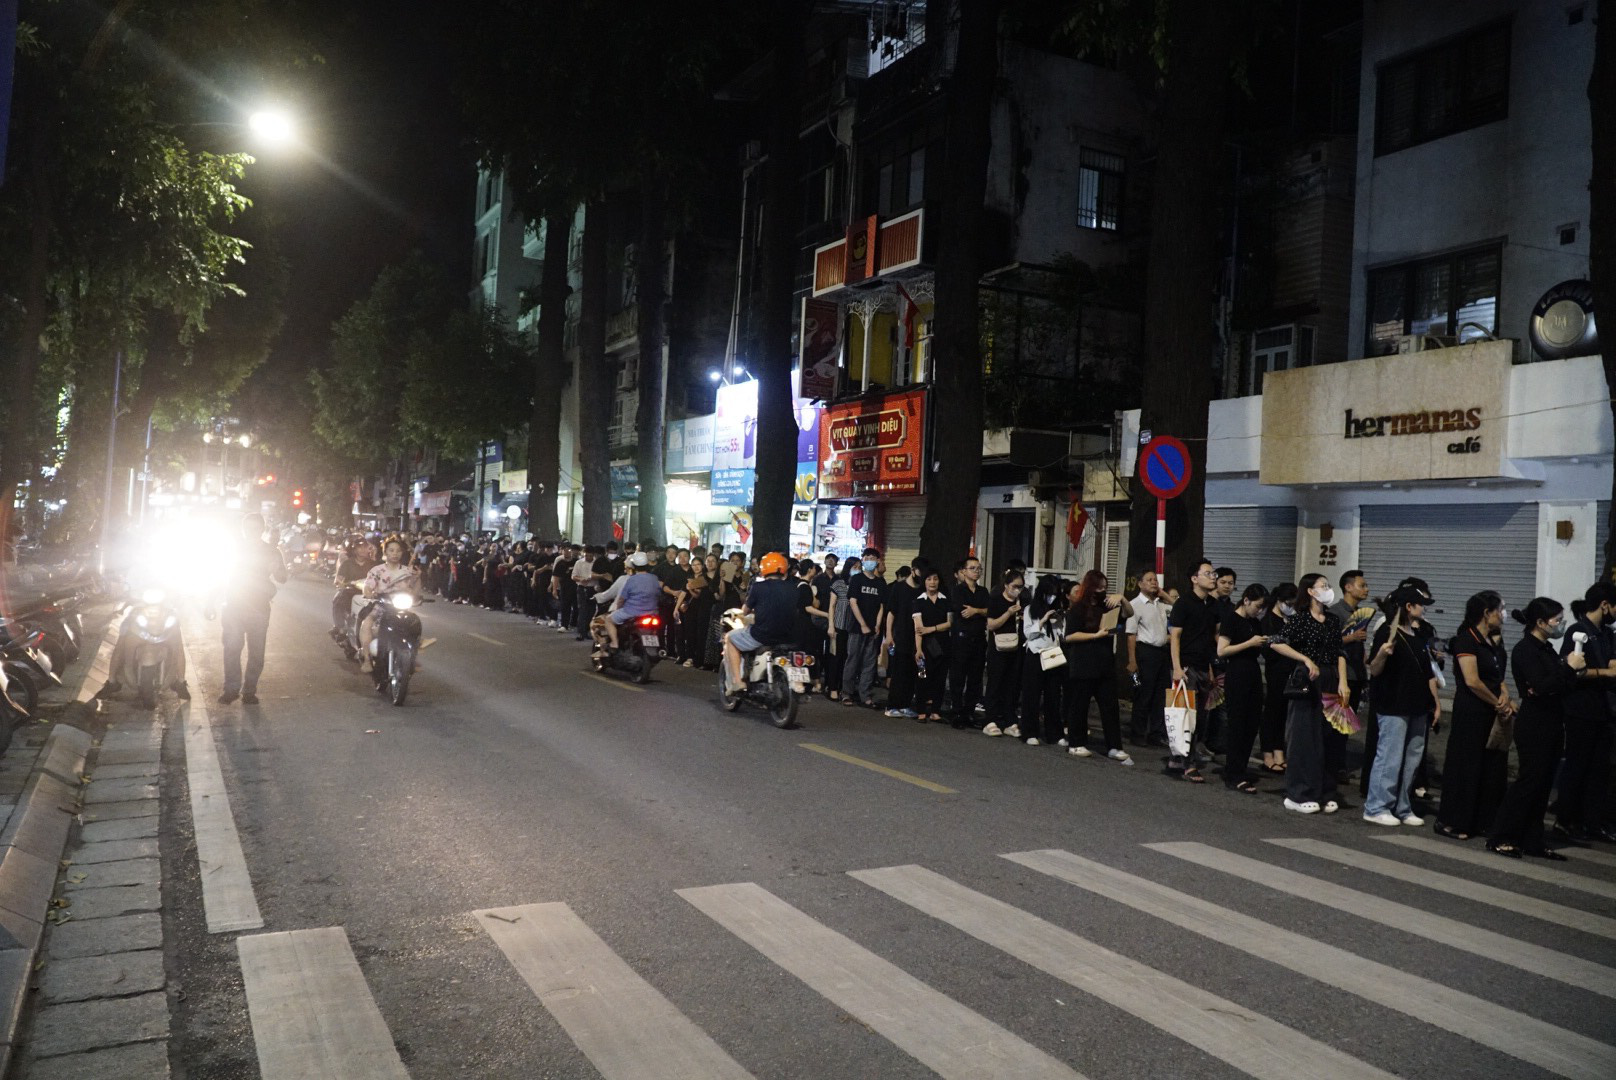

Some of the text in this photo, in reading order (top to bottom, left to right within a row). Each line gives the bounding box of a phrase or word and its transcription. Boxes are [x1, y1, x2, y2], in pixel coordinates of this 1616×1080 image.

[832, 428, 842, 442] VỊT
[843, 424, 862, 438] QUAY
[863, 422, 880, 435] VINH
[881, 417, 899, 435] DIỆU
[1344, 407, 1481, 438] hermanas
[1447, 435, 1481, 454] café
[1319, 544, 1337, 558] 25
